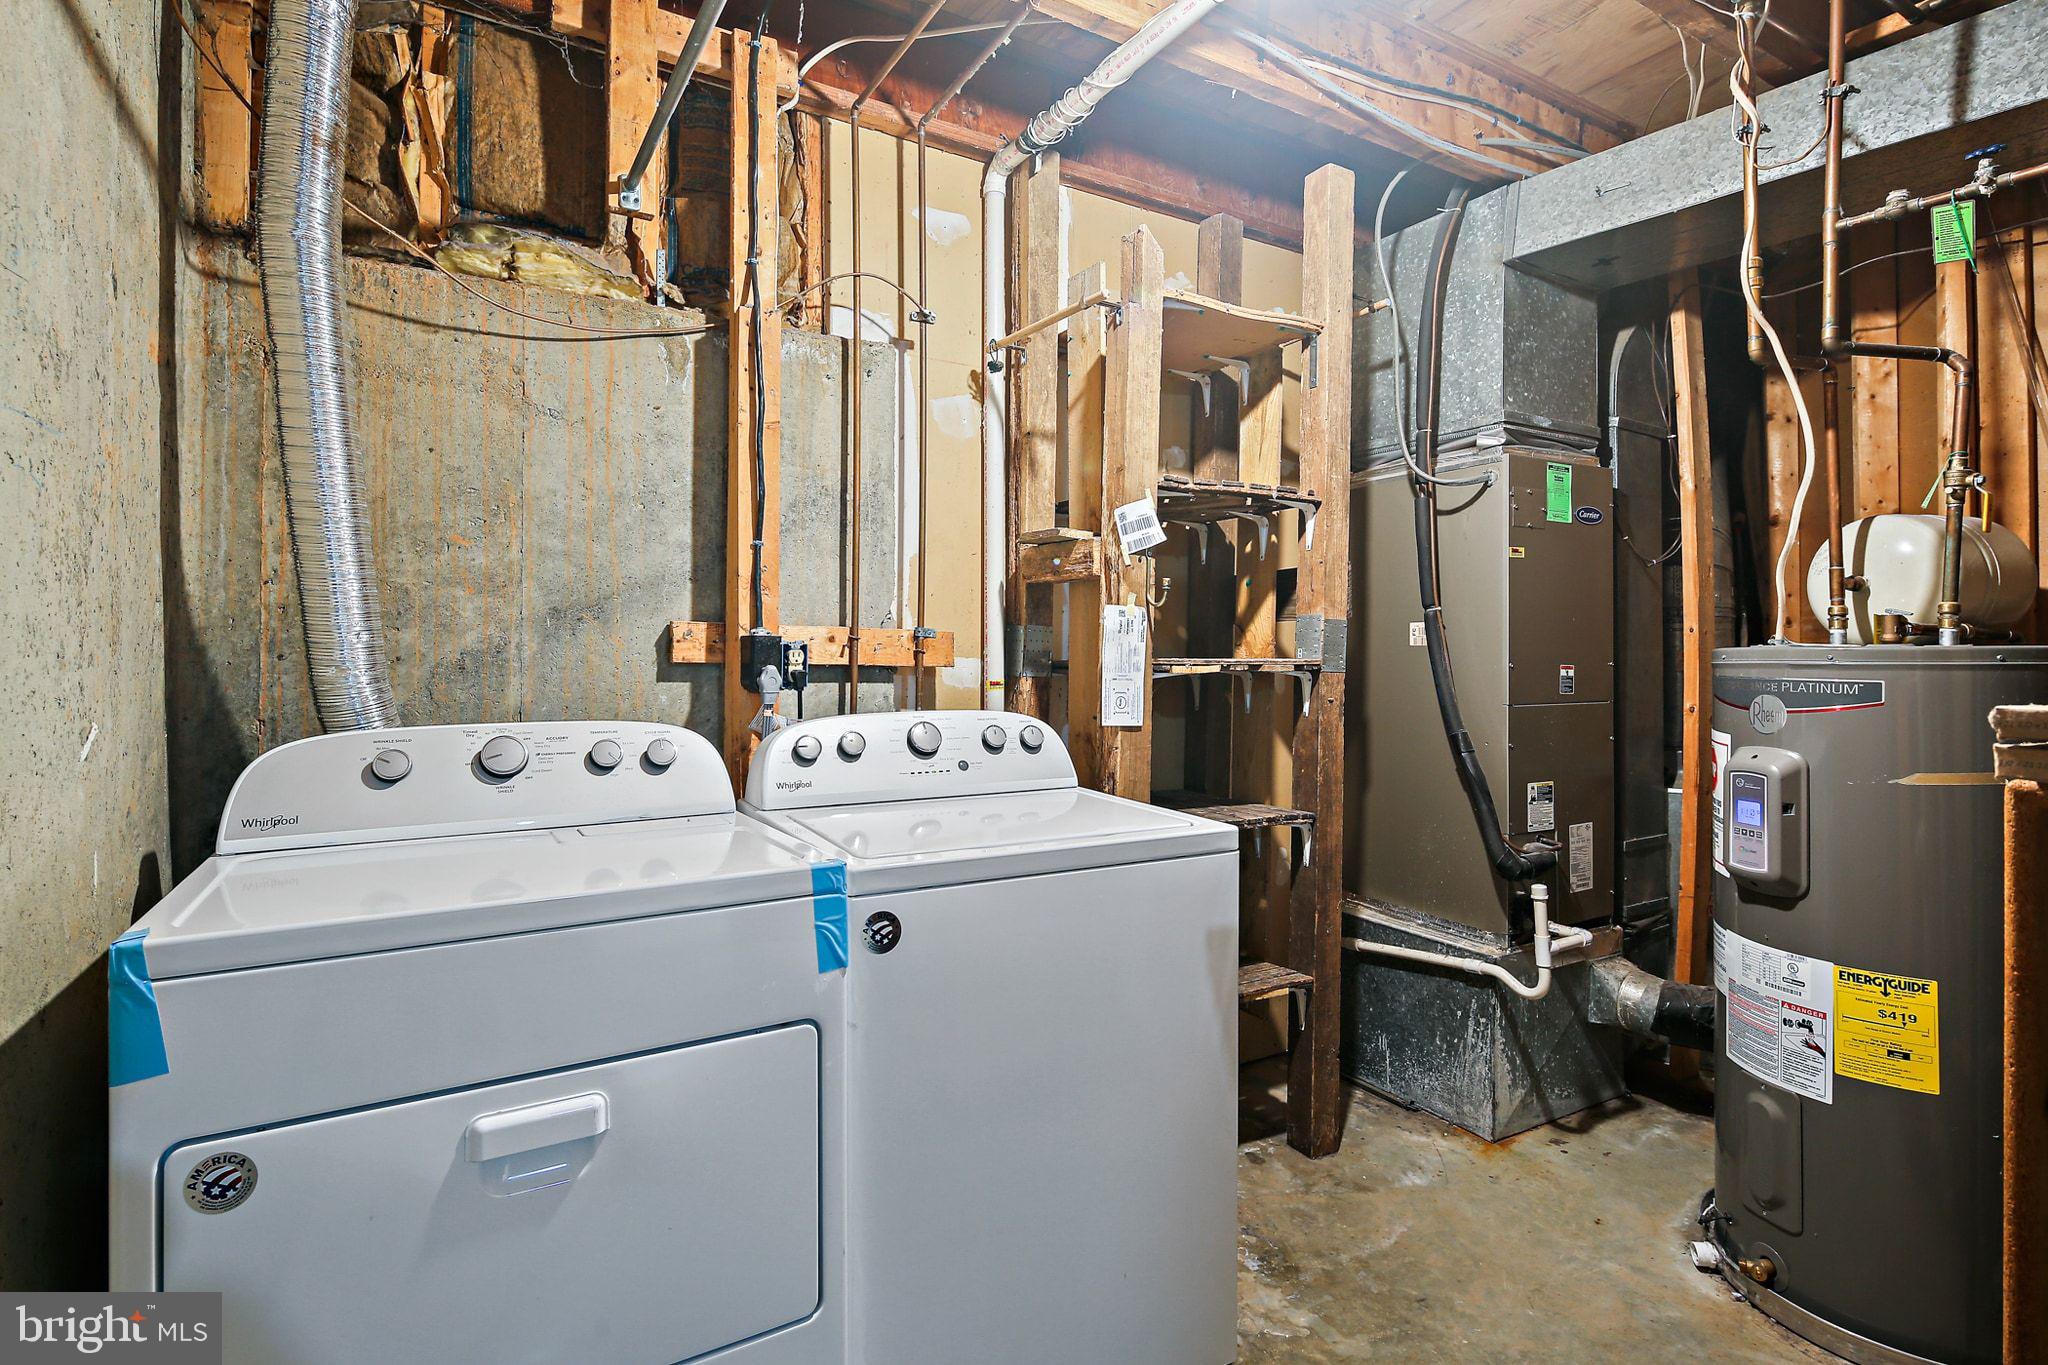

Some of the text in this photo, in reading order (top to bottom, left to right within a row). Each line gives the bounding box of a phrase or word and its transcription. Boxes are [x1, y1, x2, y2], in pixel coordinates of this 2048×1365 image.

[1580, 510, 1600, 519] Carrier
[1781, 682, 1859, 695] PLATINUM
[1752, 695, 1784, 728] Rheem
[776, 780, 812, 792] Whirlpool
[241, 815, 299, 832] Whirlpool
[1838, 970, 1931, 996] ENERGYGUIDE
[1790, 1002, 1825, 1019] DANGER
[1877, 1009, 1918, 1024] $419
[187, 1154, 247, 1191] AMERICA
